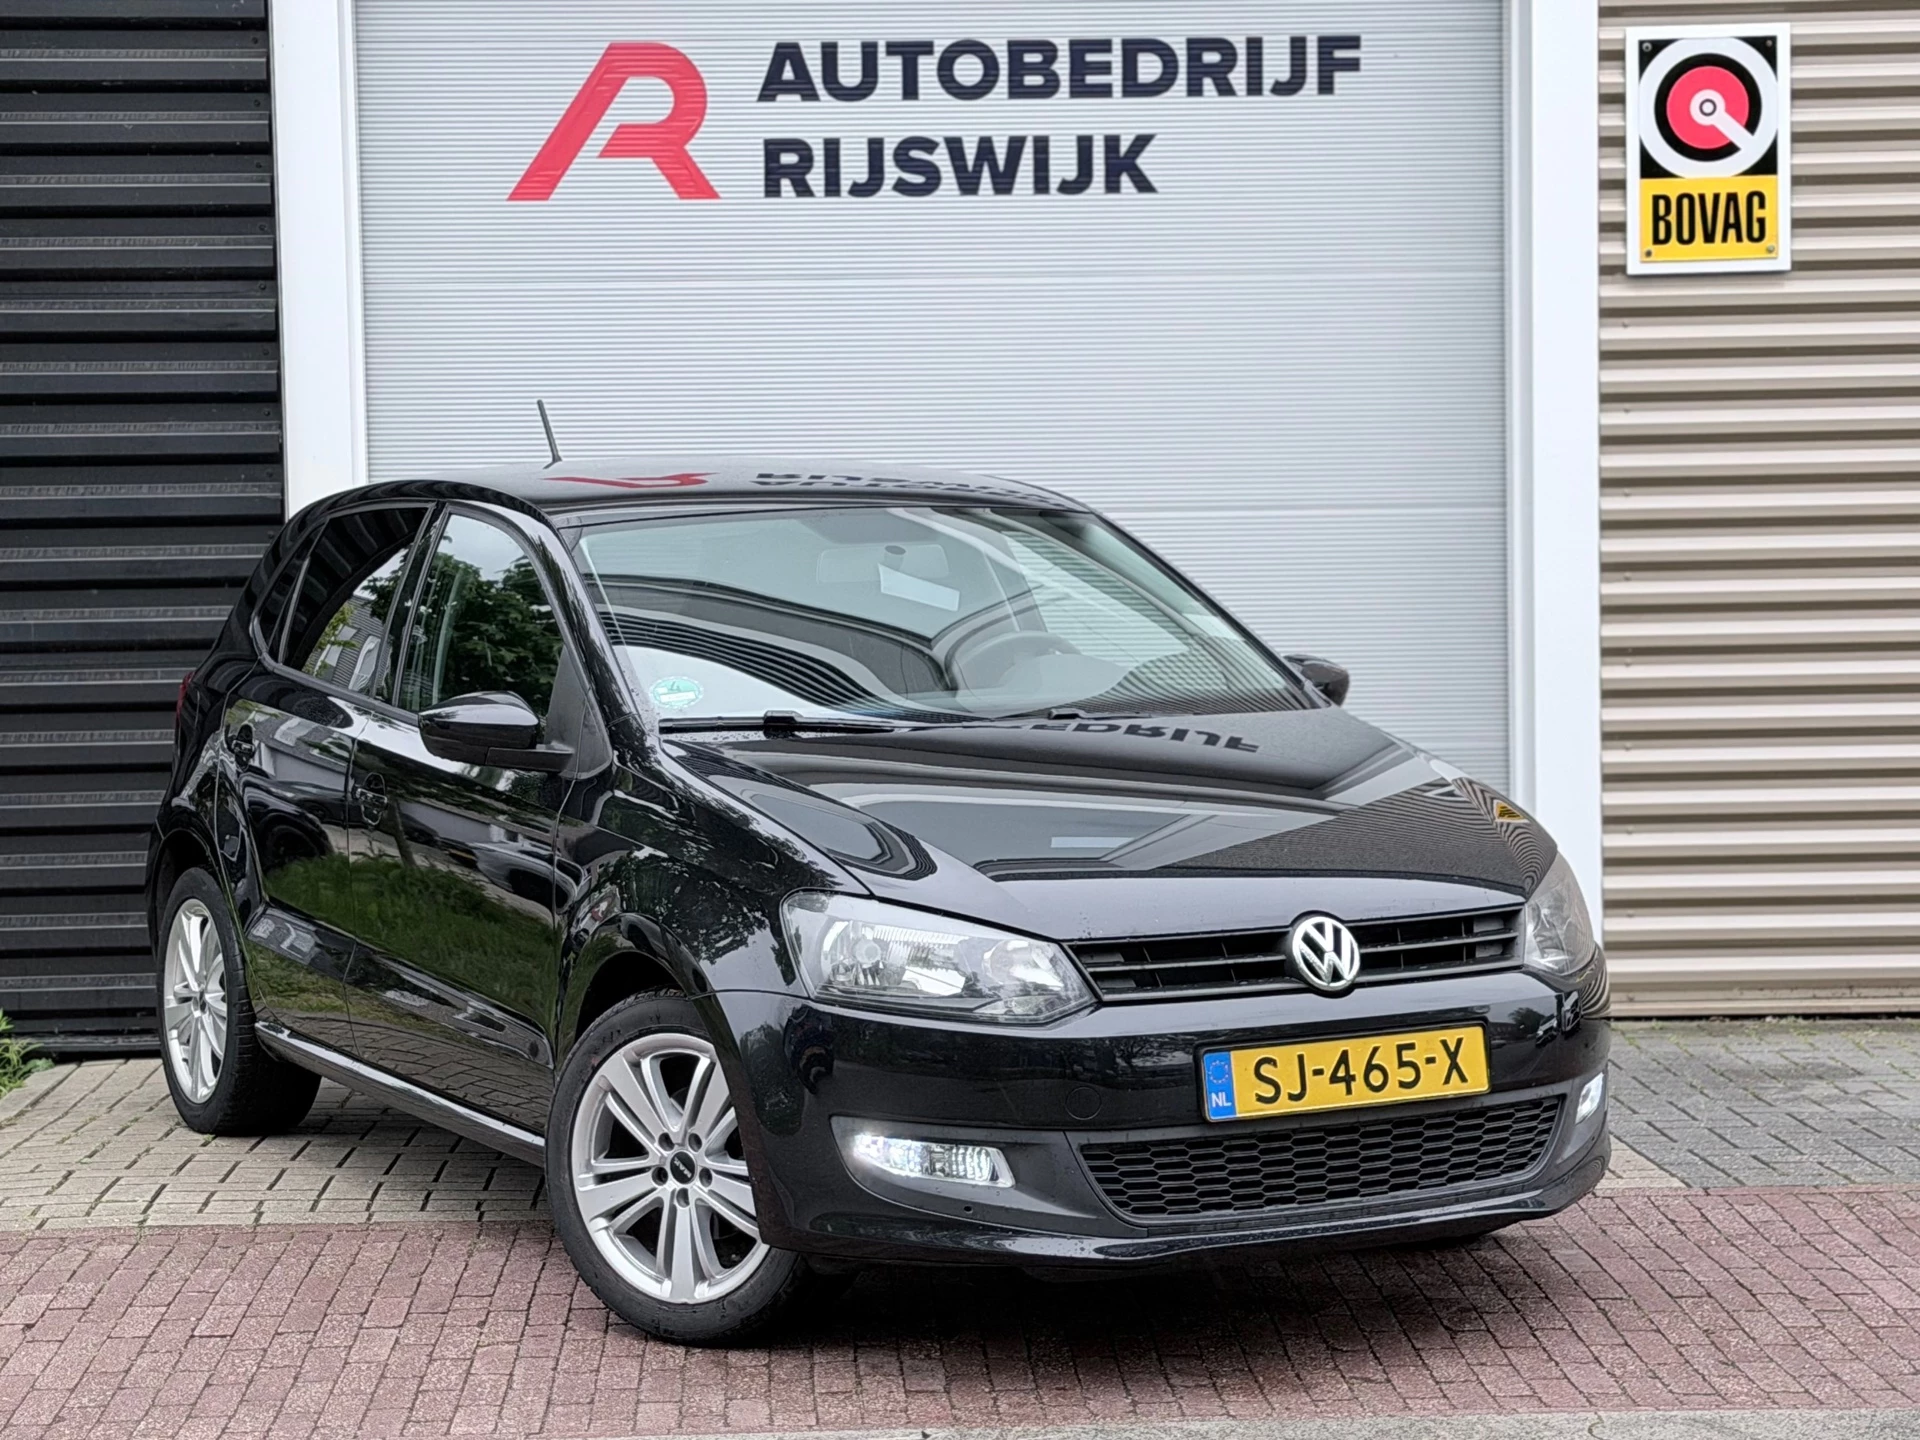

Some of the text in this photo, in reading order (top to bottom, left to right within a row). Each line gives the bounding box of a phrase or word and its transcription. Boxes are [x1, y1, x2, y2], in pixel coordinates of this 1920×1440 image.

[757, 36, 1361, 102] AUTOBEDRIJF
[763, 135, 1157, 198] RIJSWIJK
[1652, 190, 1766, 246] BOVAG
[1211, 1092, 1232, 1107] NL
[1253, 1037, 1468, 1104] SJ-465-X
